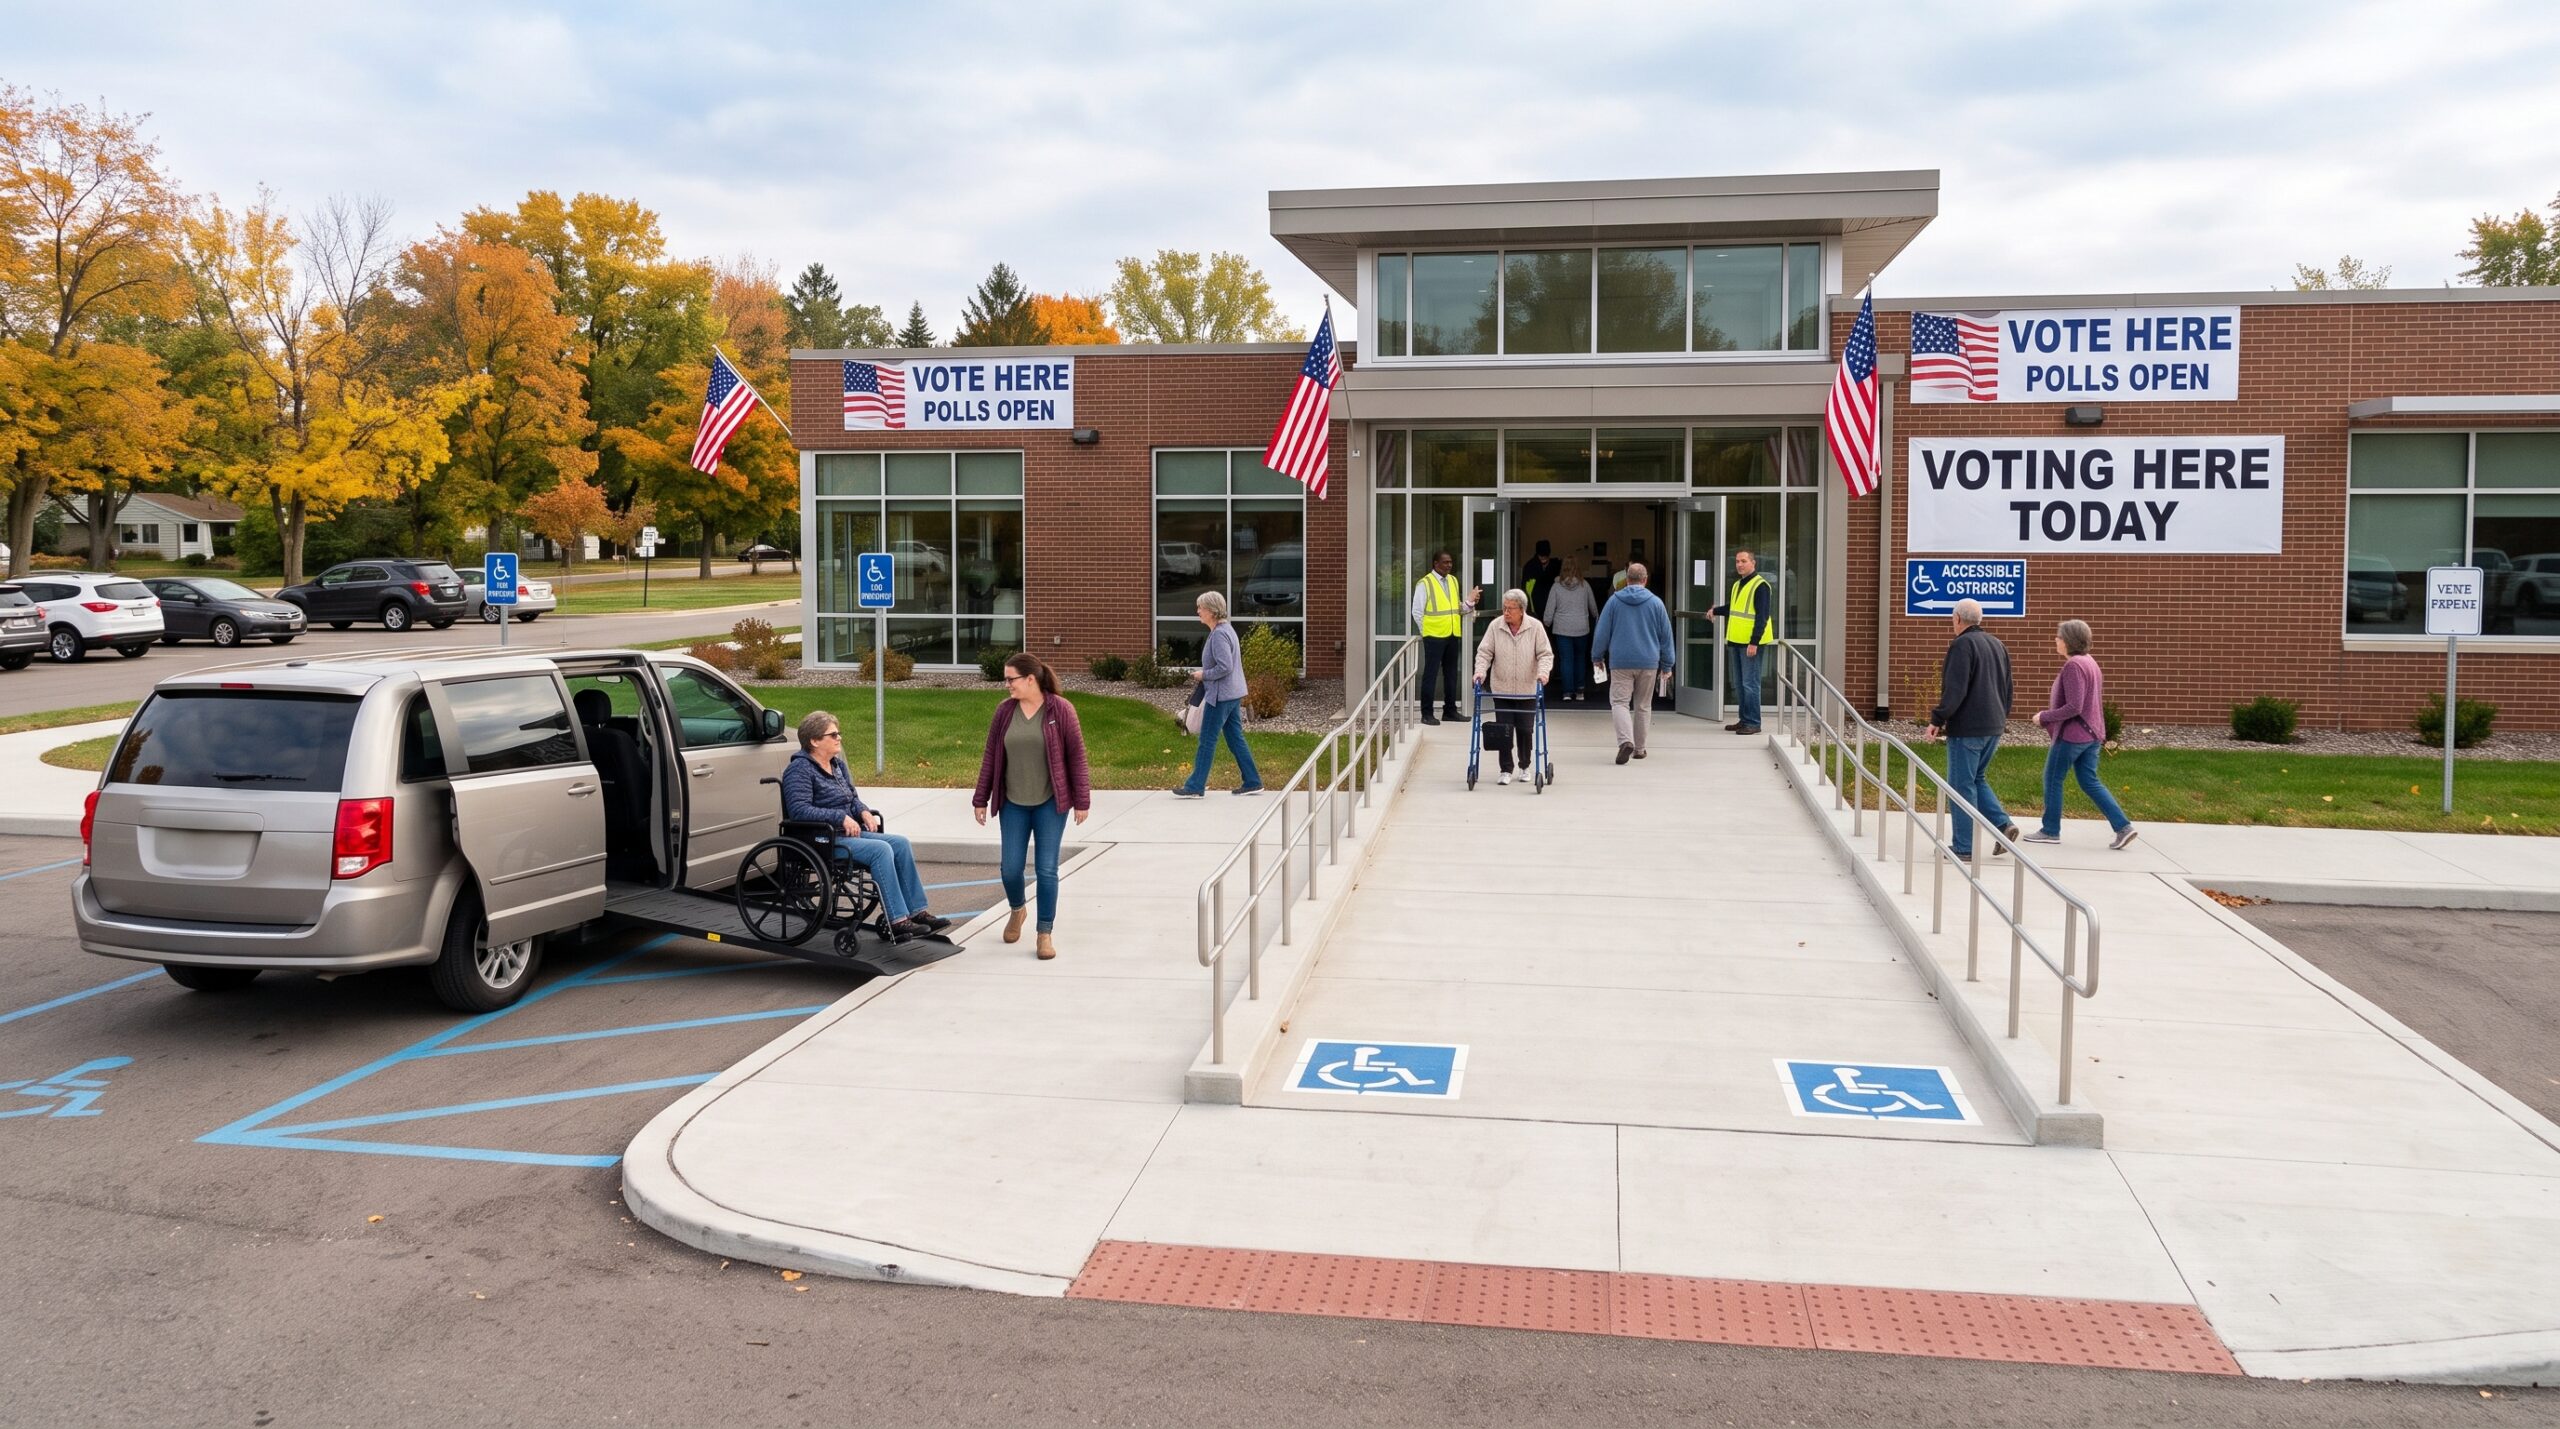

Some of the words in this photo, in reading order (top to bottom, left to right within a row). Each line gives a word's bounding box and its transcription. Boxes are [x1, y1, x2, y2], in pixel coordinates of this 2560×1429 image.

[2008, 318, 2111, 353] VOTE
[2126, 316, 2232, 351] HERE
[912, 365, 984, 392] VOTE
[995, 364, 1069, 391] HERE
[2026, 364, 2119, 392] POLLS
[2129, 363, 2209, 391] OPEN
[924, 400, 990, 421] POLLS
[997, 399, 1055, 421] OPEN
[1922, 449, 2114, 490] VOTING
[2133, 448, 2270, 489] HERE
[2010, 500, 2179, 541] TODAY
[1941, 564, 2021, 578] ACCESSIBLE
